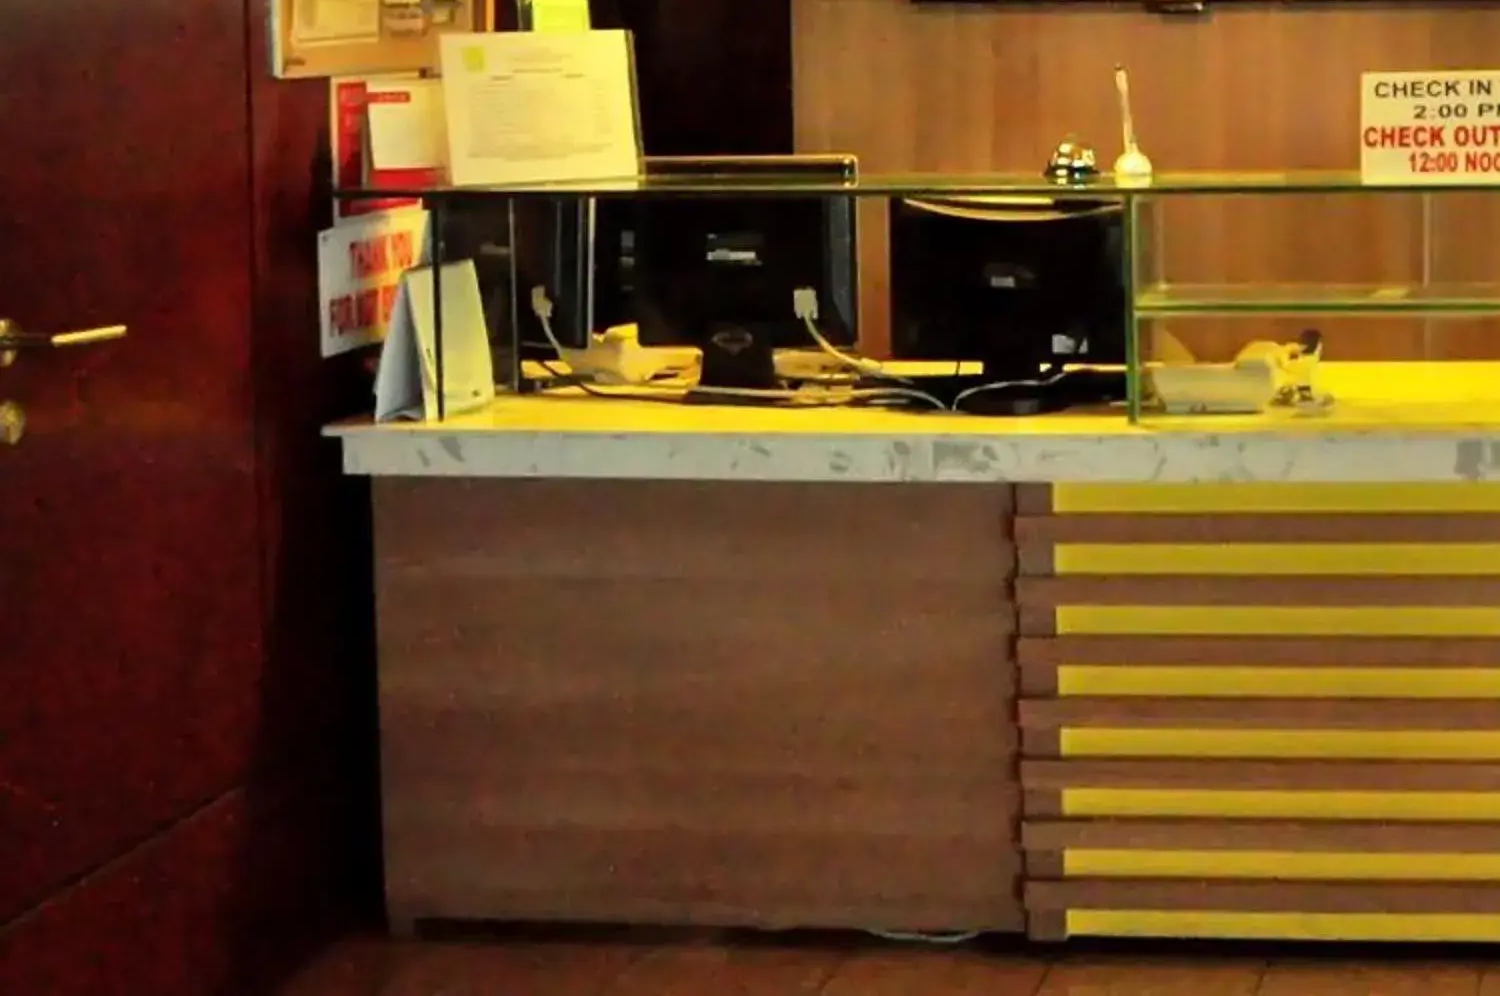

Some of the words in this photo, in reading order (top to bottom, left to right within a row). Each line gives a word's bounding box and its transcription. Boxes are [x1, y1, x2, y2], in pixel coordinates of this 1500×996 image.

[1375, 80, 1460, 97] CHECK
[1469, 80, 1492, 95] IN
[1413, 105, 1467, 119] 2:00
[1363, 126, 1445, 147] CHECK
[1454, 126, 1500, 146] OUT
[1409, 152, 1458, 172] 12:00
